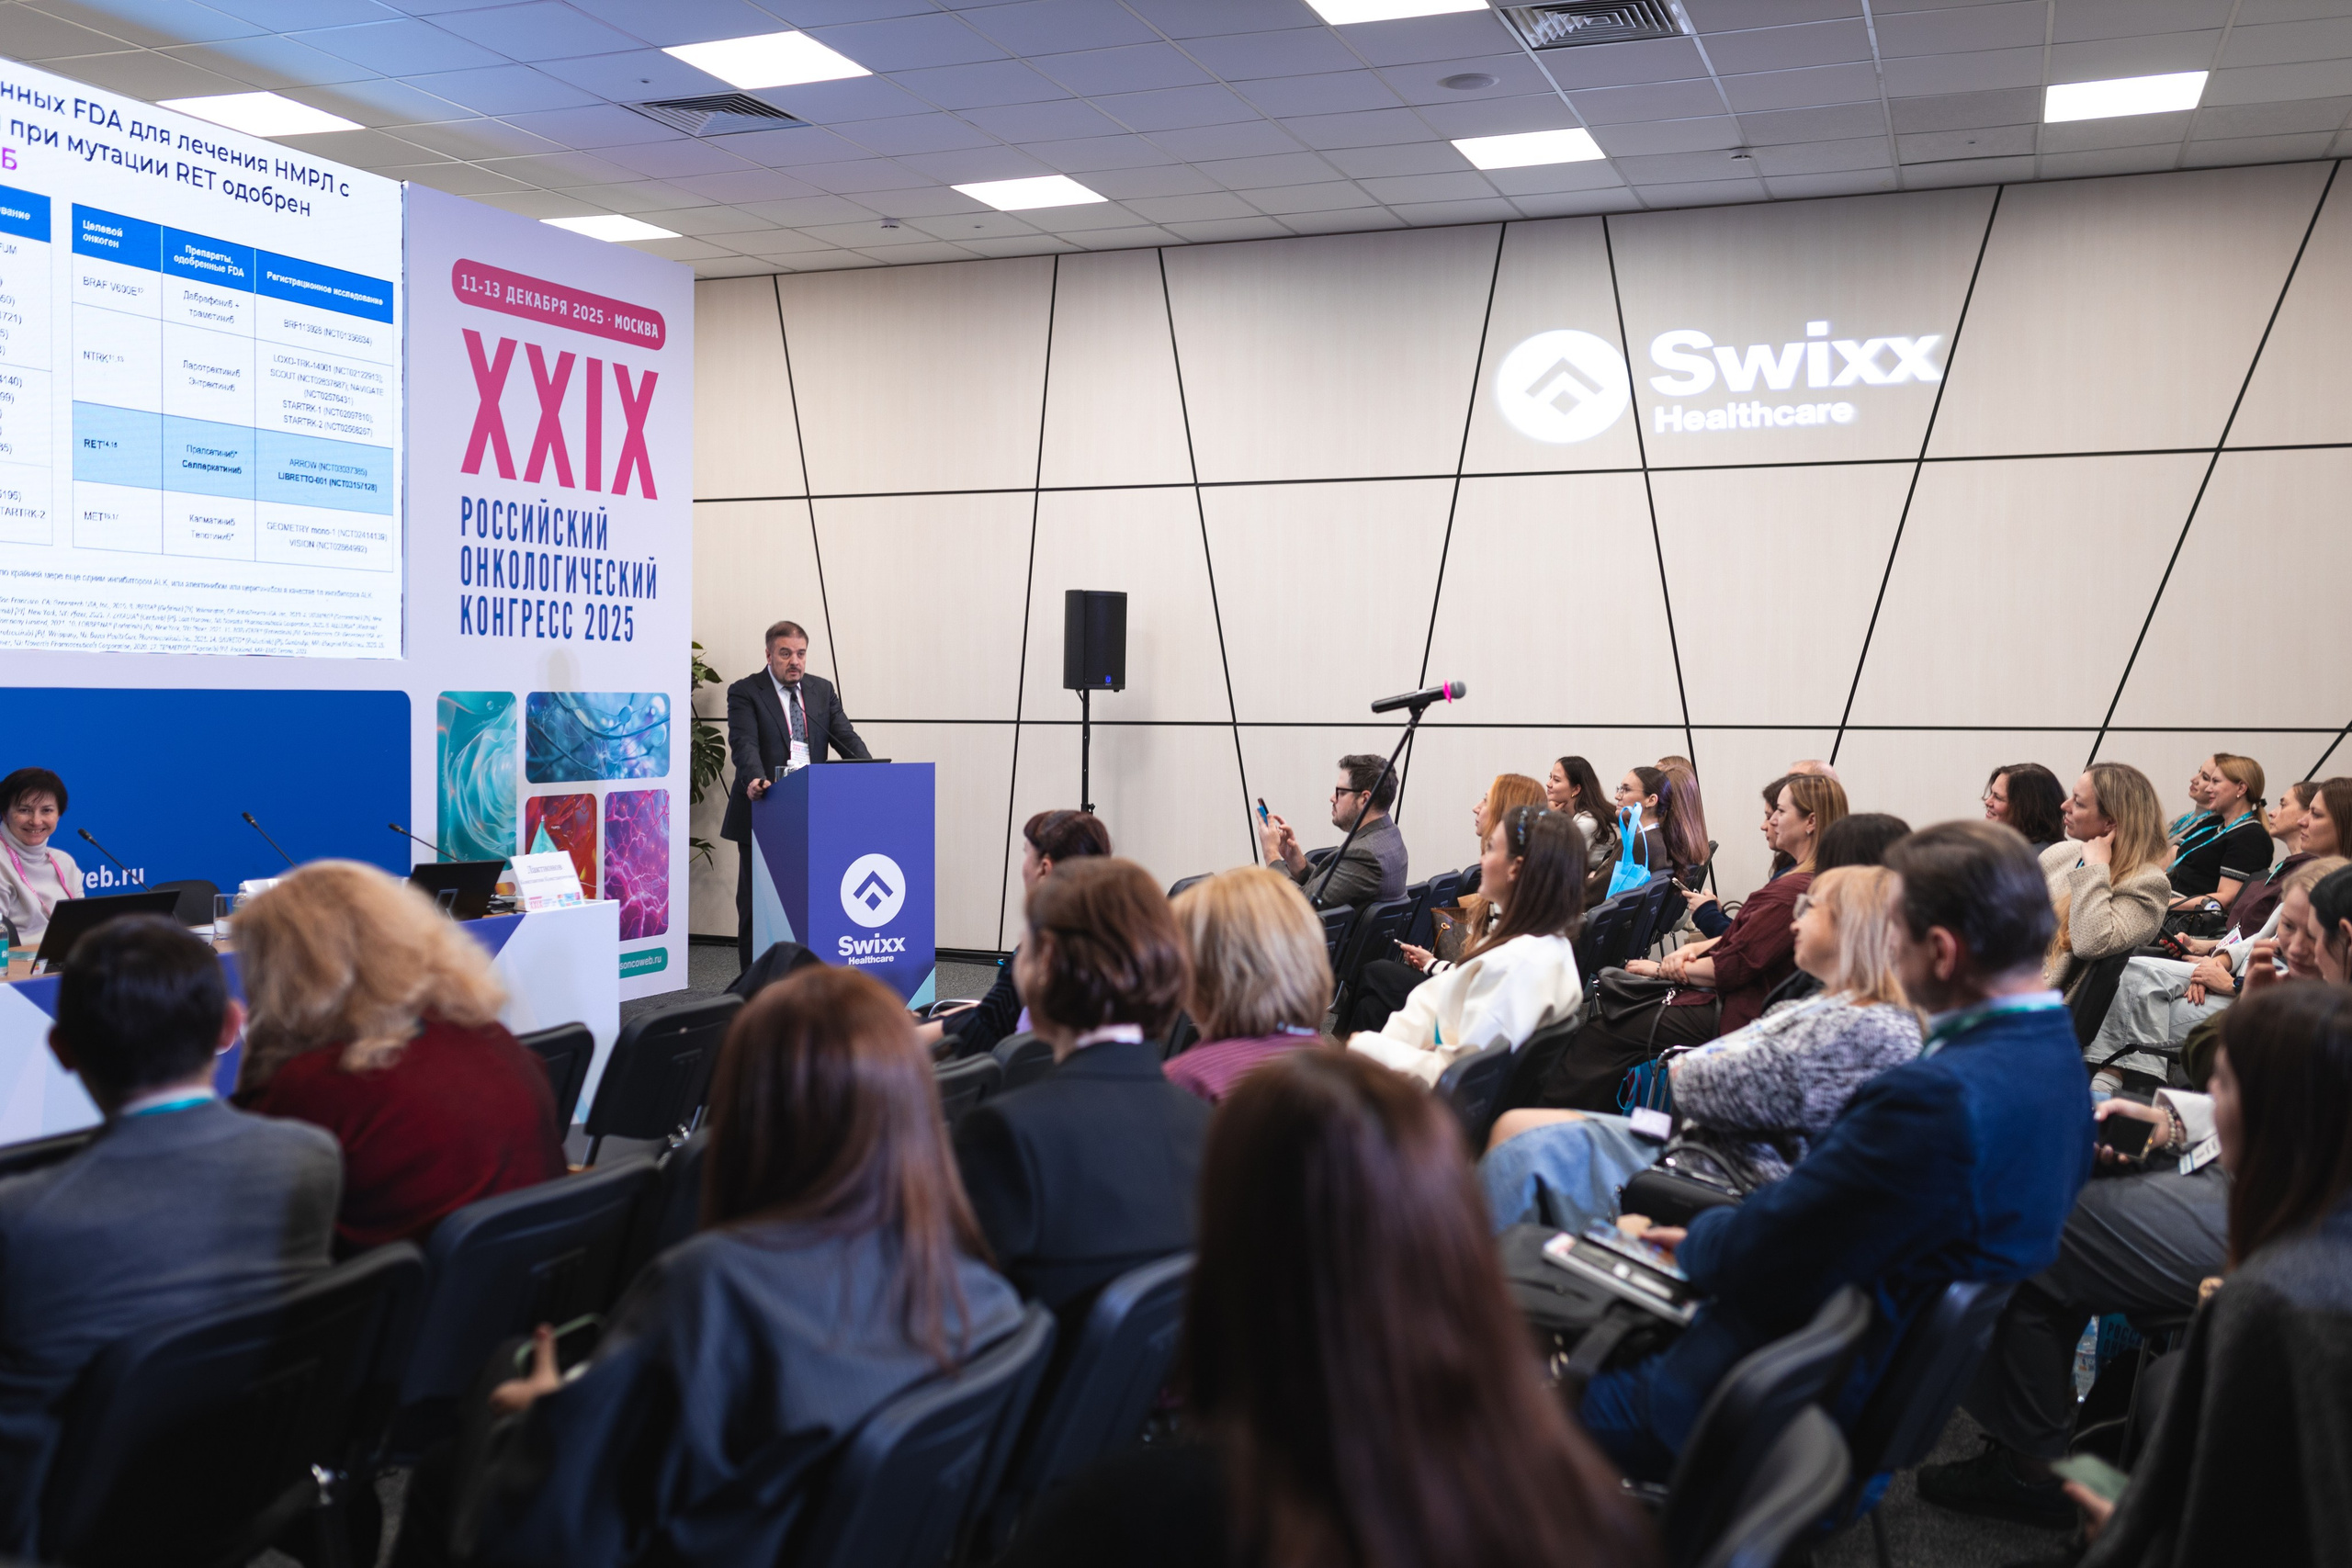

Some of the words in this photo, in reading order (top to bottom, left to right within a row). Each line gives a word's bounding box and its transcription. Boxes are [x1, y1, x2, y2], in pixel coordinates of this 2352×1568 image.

[74, 97, 122, 132] FDA
[130, 120, 170, 145] для
[177, 134, 267, 174] лечения
[276, 158, 333, 193] НМРЛ
[340, 182, 349, 197] с
[11, 118, 58, 147] при
[68, 134, 168, 178] мутации
[176, 161, 217, 190] RET
[222, 179, 311, 217] одобрен
[0, 206, 30, 220] вание
[83, 220, 123, 238] Целевой
[83, 233, 119, 249] онкоген
[174, 254, 226, 274] одобренные
[228, 265, 245, 277] FDA
[186, 244, 233, 265] Препараты,
[83, 276, 107, 289] BRAF
[266, 271, 332, 294] Регистрационное
[334, 288, 384, 306] исследование
[184, 289, 233, 309] Дабрафениб
[461, 274, 501, 299] 11-13
[506, 286, 567, 315] ДЕКАБРЯ
[572, 303, 604, 324] 2025
[615, 313, 659, 339] МОСКВА
[1649, 320, 1944, 397] Swixx
[270, 368, 296, 380] SCOUT
[283, 414, 323, 429] STARTRK-2
[460, 327, 660, 501] XXIX
[1655, 400, 1856, 434] Healthcare
[182, 459, 242, 475] Селперкатиниб
[288, 458, 317, 469] ARROW
[277, 471, 327, 485] LIBRETTO-001
[460, 495, 607, 551] РОССИЙСКИЙ
[289, 538, 314, 548] VISION
[460, 545, 657, 600] ОНКОЛОГИЧЕСКИЙ
[460, 594, 573, 640] КОНГРЕСС
[584, 603, 634, 642] 2025
[82, 865, 144, 889] eb.ru
[838, 932, 906, 956] Swixx
[848, 954, 895, 965] Healthcare
